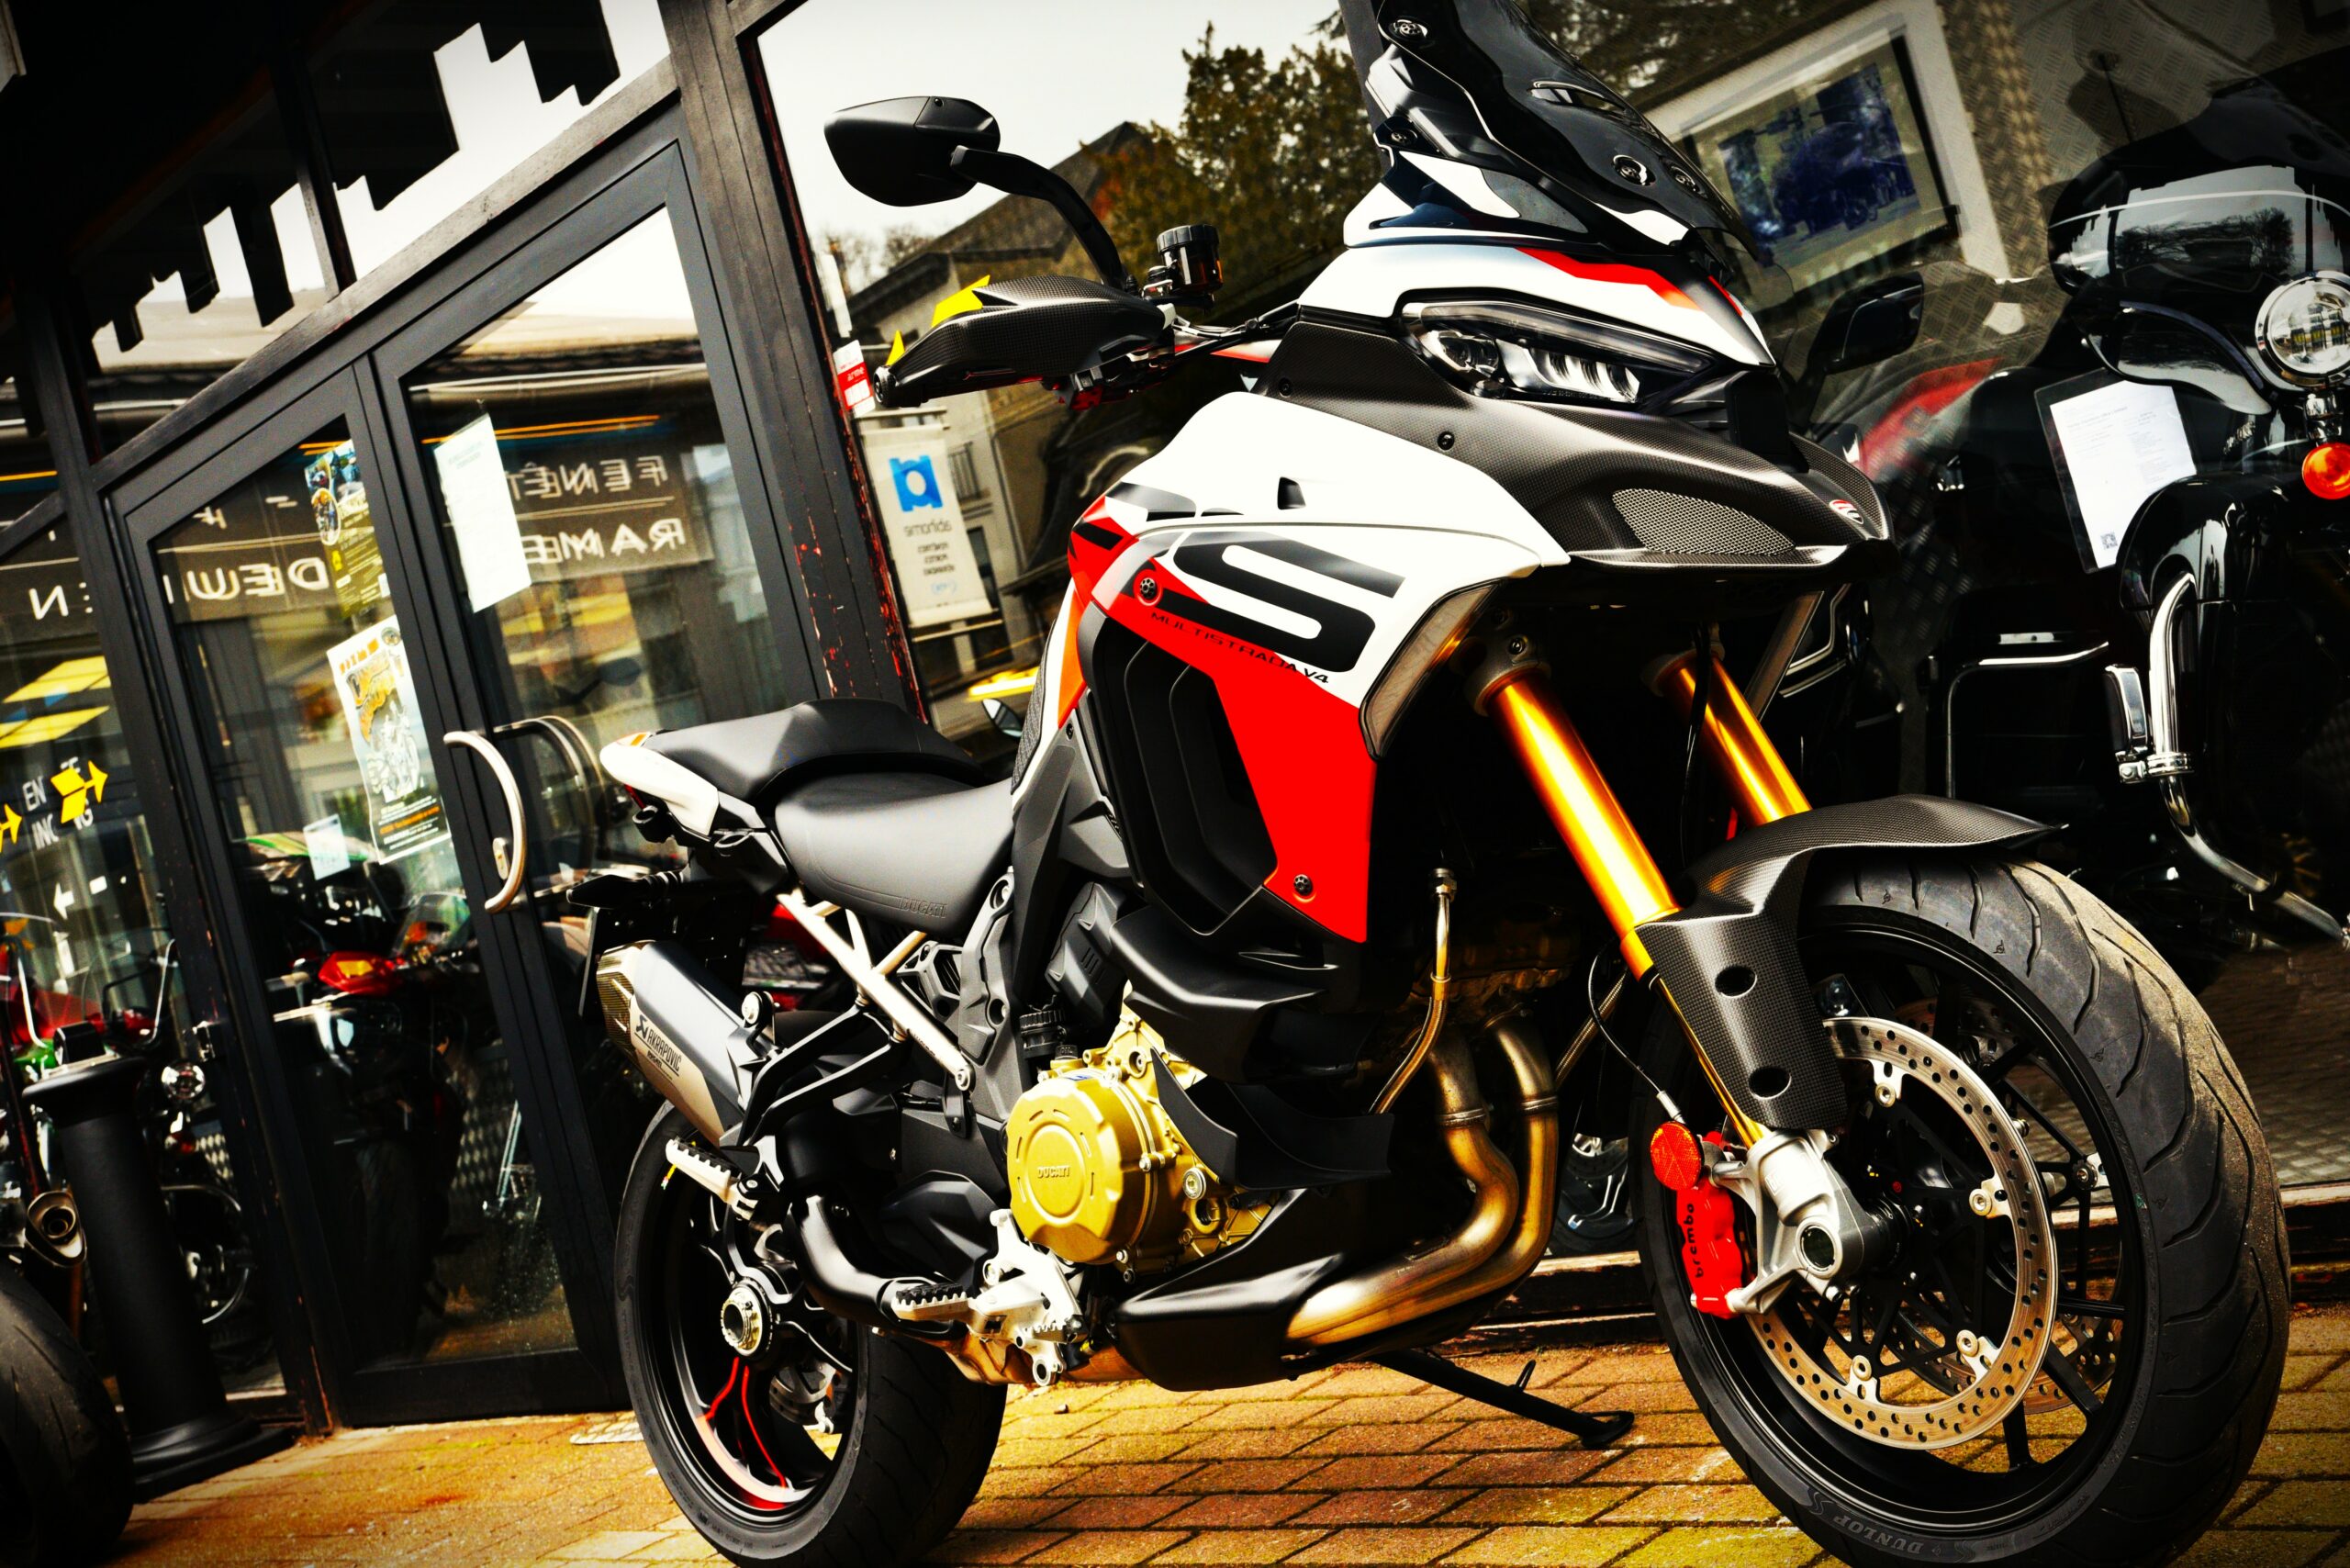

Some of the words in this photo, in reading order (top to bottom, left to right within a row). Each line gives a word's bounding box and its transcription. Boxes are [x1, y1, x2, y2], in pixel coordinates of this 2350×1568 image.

[1150, 611, 1297, 672] MULTISTRADA
[1304, 666, 1329, 685] V4
[1037, 1165, 1070, 1179] DUCATI
[1684, 1203, 1705, 1278] brembo
[1835, 1515, 1924, 1554] DUNLOP
